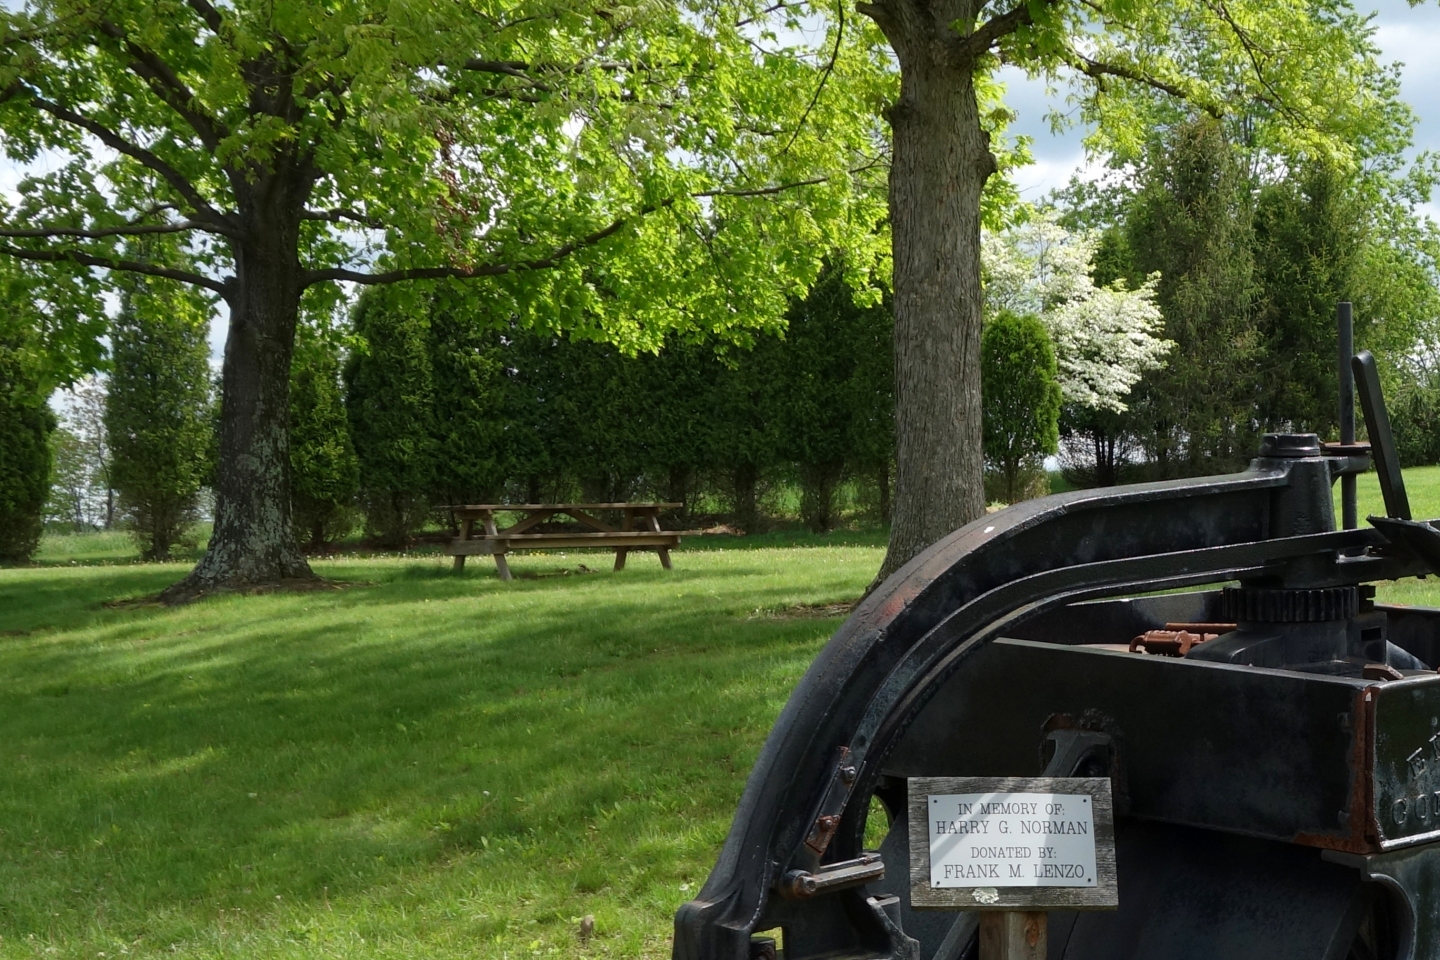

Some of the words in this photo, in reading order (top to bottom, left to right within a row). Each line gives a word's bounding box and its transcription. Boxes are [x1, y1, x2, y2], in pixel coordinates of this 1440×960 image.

[957, 803, 973, 815] IN
[980, 803, 1037, 815] MEMORY
[1045, 803, 1065, 815] OF:
[935, 820, 990, 835] HARRY
[998, 820, 1012, 835] G.
[1021, 821, 1088, 835] NORMAN
[970, 846, 1032, 859] DONATED
[1038, 847, 1057, 859] BY:
[943, 864, 999, 879] FRANK
[1008, 864, 1025, 878] M.
[1034, 864, 1084, 879] LENZO
